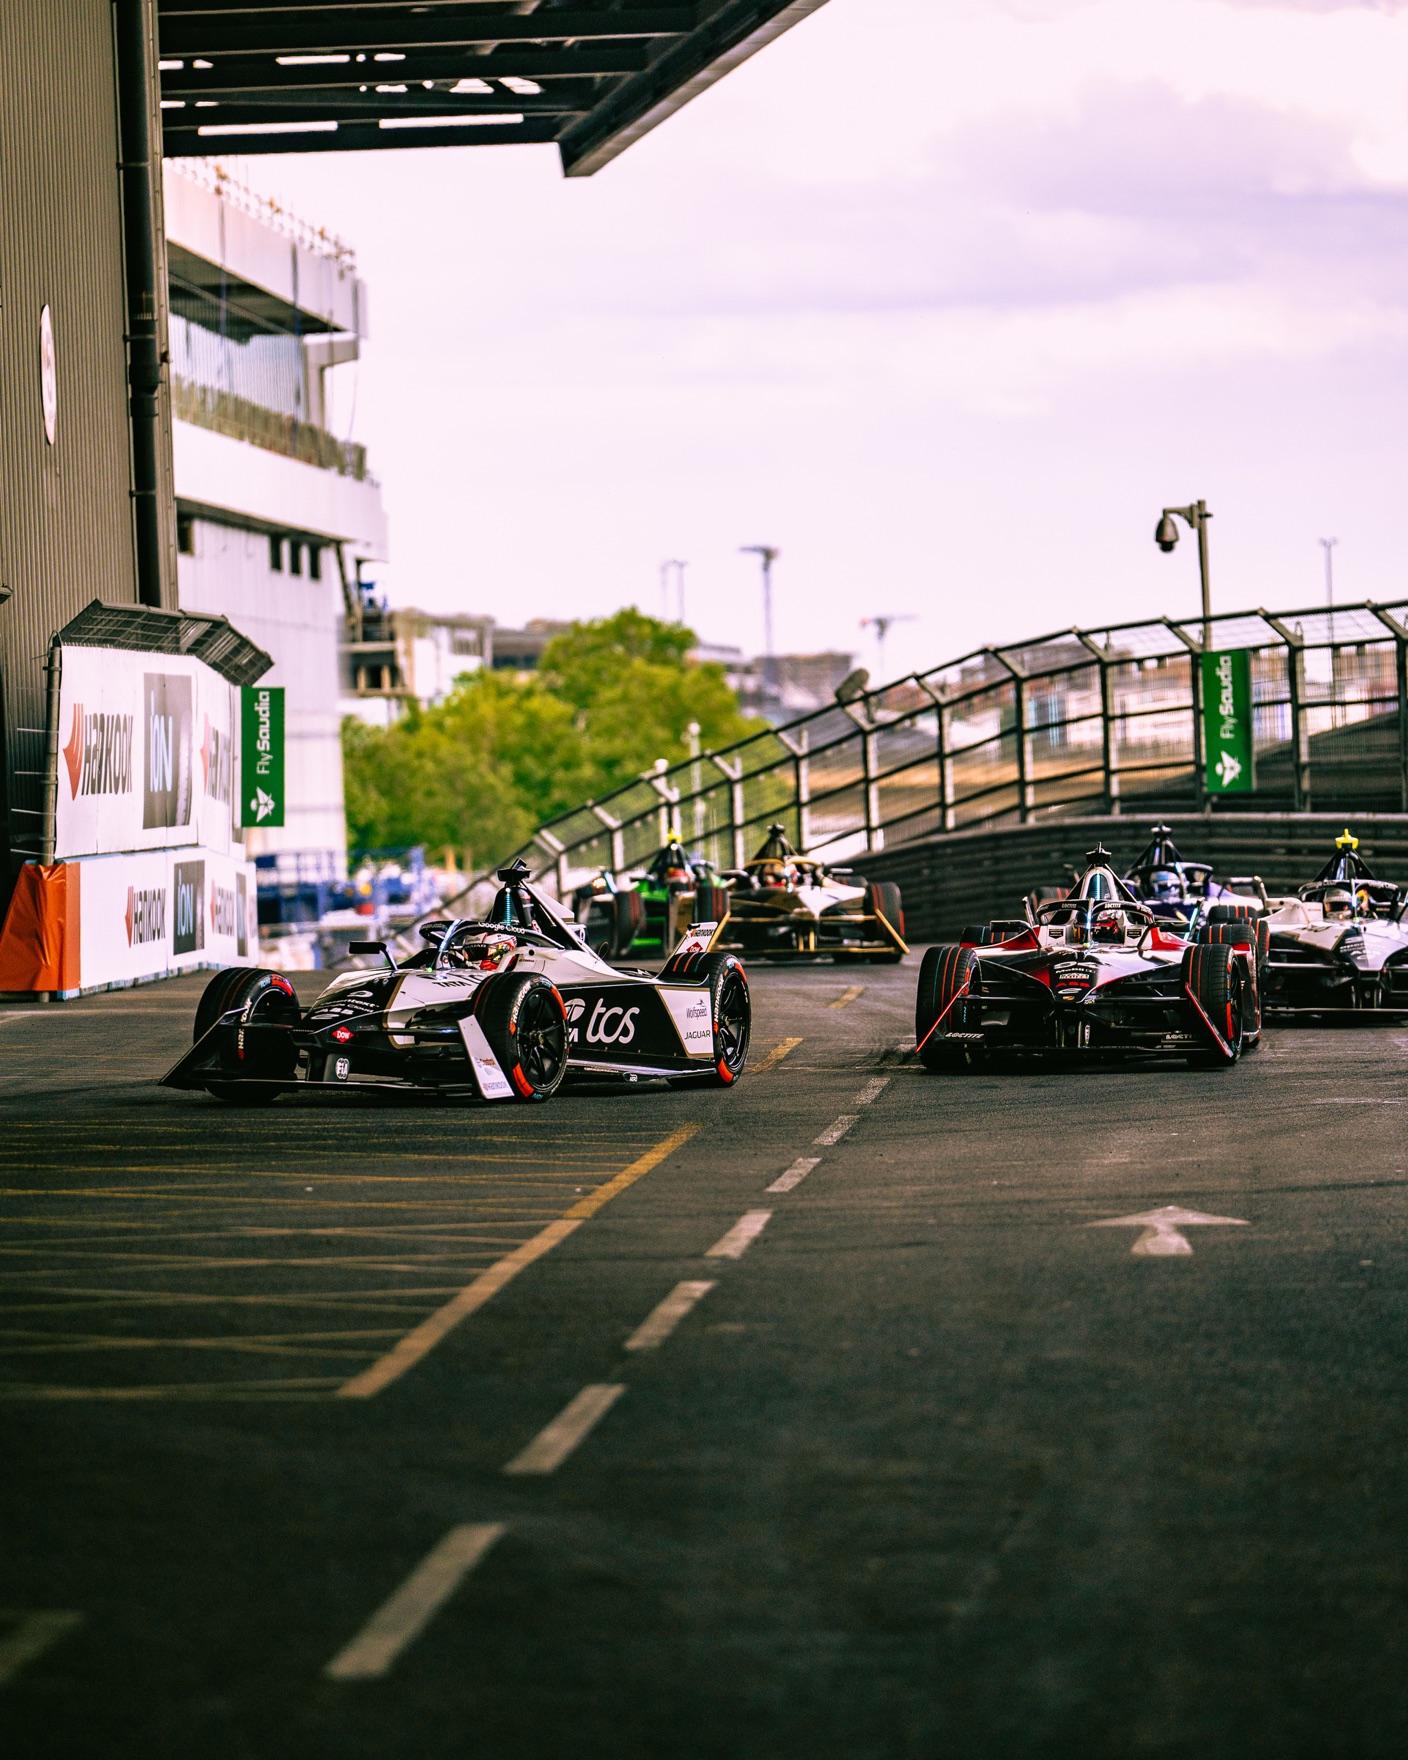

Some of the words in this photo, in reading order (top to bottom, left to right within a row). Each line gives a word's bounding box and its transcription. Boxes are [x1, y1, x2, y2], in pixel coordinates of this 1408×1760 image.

[478, 921, 505, 932] Google
[505, 924, 526, 934] Cloud
[586, 997, 640, 1044] tcs
[684, 1029, 711, 1040] JAGUAR
